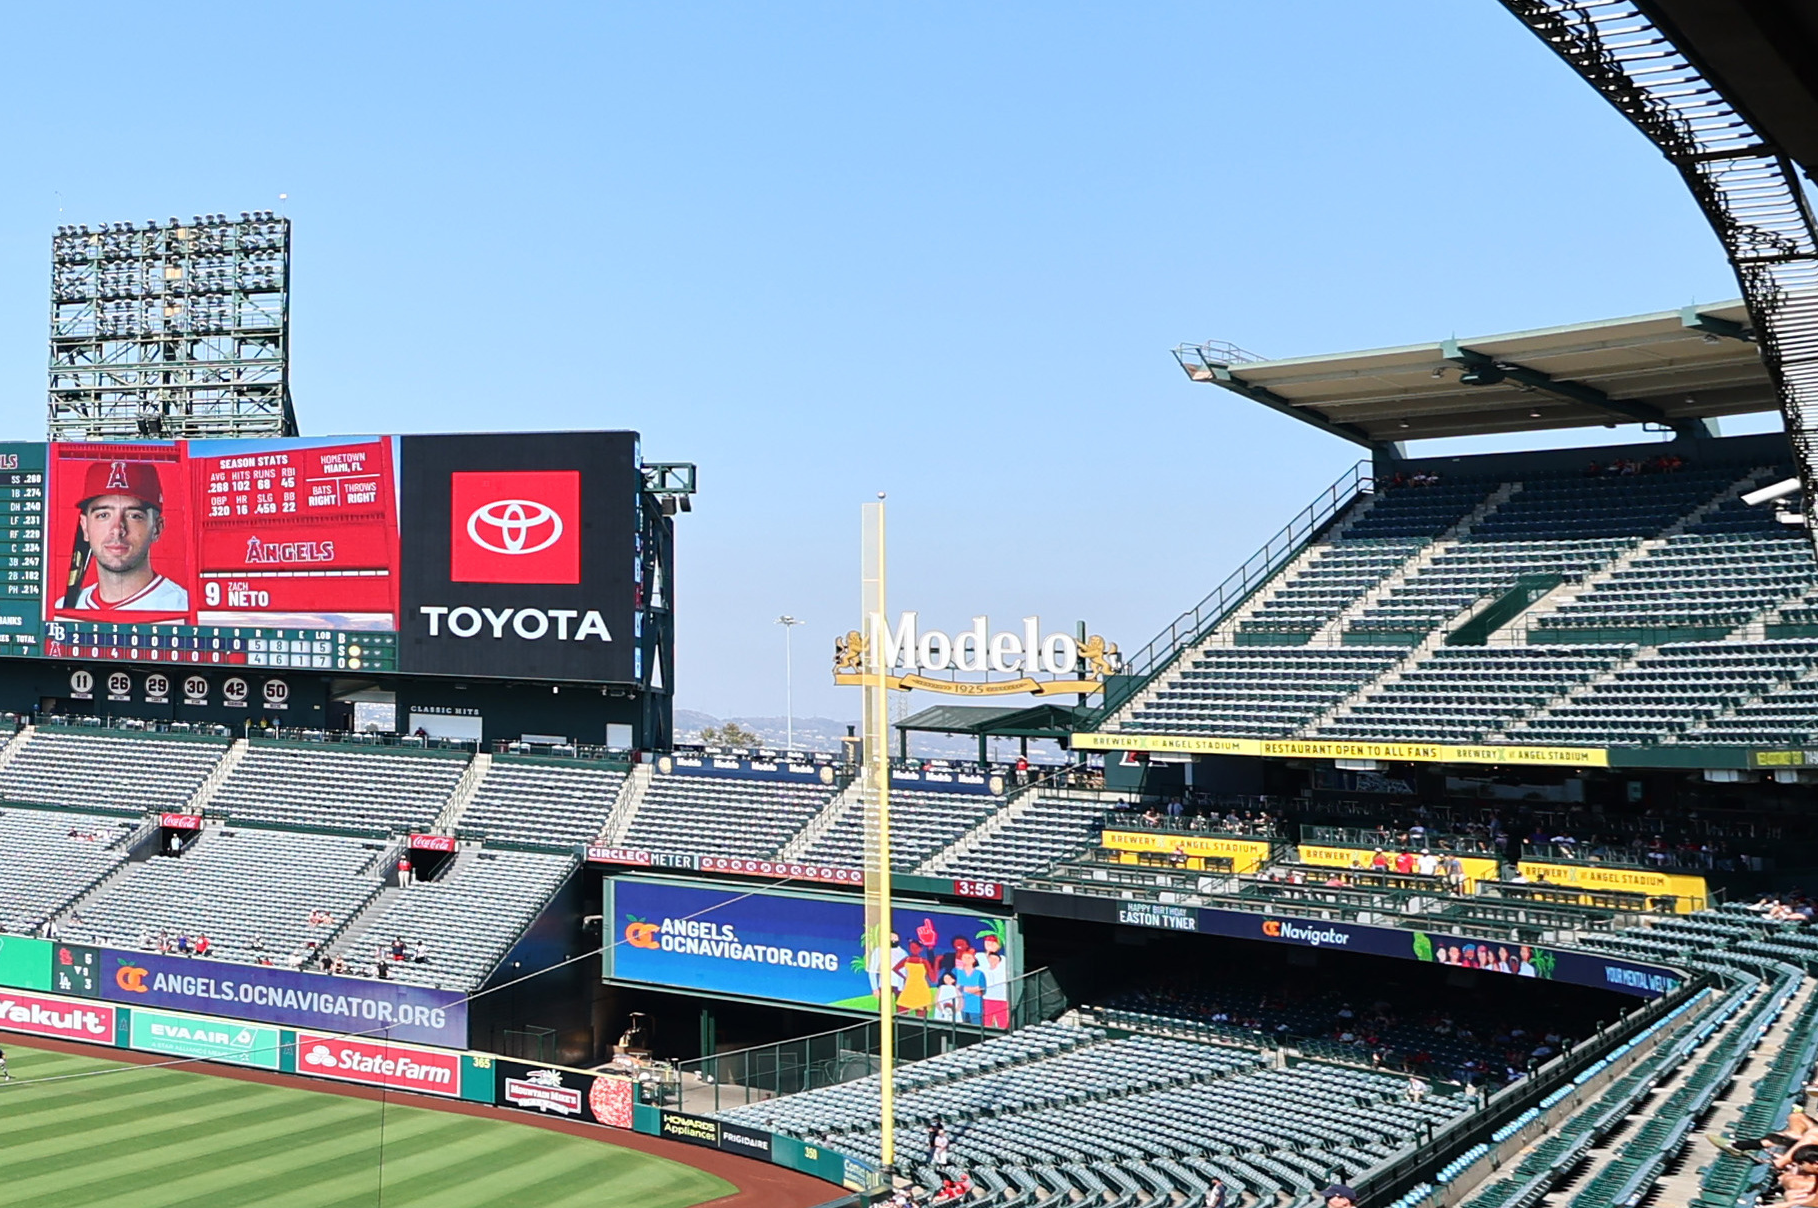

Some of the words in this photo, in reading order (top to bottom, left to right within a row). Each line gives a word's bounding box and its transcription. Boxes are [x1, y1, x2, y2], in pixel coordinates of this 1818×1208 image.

[219, 457, 256, 470] SEASON
[257, 455, 289, 467] STATS
[320, 452, 366, 464] HOMETOWN
[232, 471, 250, 480] HITS
[245, 536, 334, 563] ANGELS
[205, 583, 220, 606] 9
[228, 591, 269, 607] NETO
[420, 606, 612, 642] TOYOTA
[870, 611, 1077, 674] Modelo
[76, 675, 87, 688] 11
[111, 676, 129, 690] 26
[148, 678, 167, 692] 29
[410, 705, 453, 714] CLASSIC
[455, 708, 479, 716] HITS
[1093, 737, 1138, 747] BREWERY
[1161, 739, 1193, 749] ANGEL
[1195, 740, 1240, 750] STADIUM
[1265, 743, 1332, 755] RESTAURANT
[1335, 744, 1363, 756] OPEN
[1367, 746, 1381, 756] TO
[1385, 746, 1404, 757] ALL
[1408, 747, 1437, 758] FANS
[1457, 749, 1496, 759] BREWERY
[1518, 751, 1547, 760] ANGEL
[1548, 752, 1589, 762] STADIUM
[1111, 835, 1156, 846] BREWERY
[1180, 840, 1211, 851] ANGEL
[1213, 842, 1259, 853] STADIUM
[588, 847, 635, 863] CIRCLE
[650, 852, 692, 869] METER
[1306, 849, 1352, 860] BREWERY
[1525, 866, 1569, 879] BREWERY
[1590, 871, 1620, 882] ANGEL
[1621, 874, 1665, 886] STADIUM
[960, 881, 995, 898] 3:56
[1127, 902, 1151, 913] HAPPY
[1152, 905, 1187, 916] BIRTHDAY
[1120, 911, 1160, 925] EASTON
[1163, 915, 1196, 930] TYNER
[661, 918, 738, 943] ANGELS.
[1281, 922, 1350, 946] Navigator
[661, 936, 838, 971] OCNAVIGATOR.ORG
[153, 972, 445, 1030] ANGELS.OCNAVIGATOR.ORG
[151, 1024, 192, 1040] EVA
[194, 1029, 229, 1046] AIR
[472, 1057, 491, 1070] 365
[663, 1114, 716, 1132] HOWARDS
[664, 1122, 716, 1141] Appliances
[723, 1132, 769, 1150] FRIGIDAIRE
